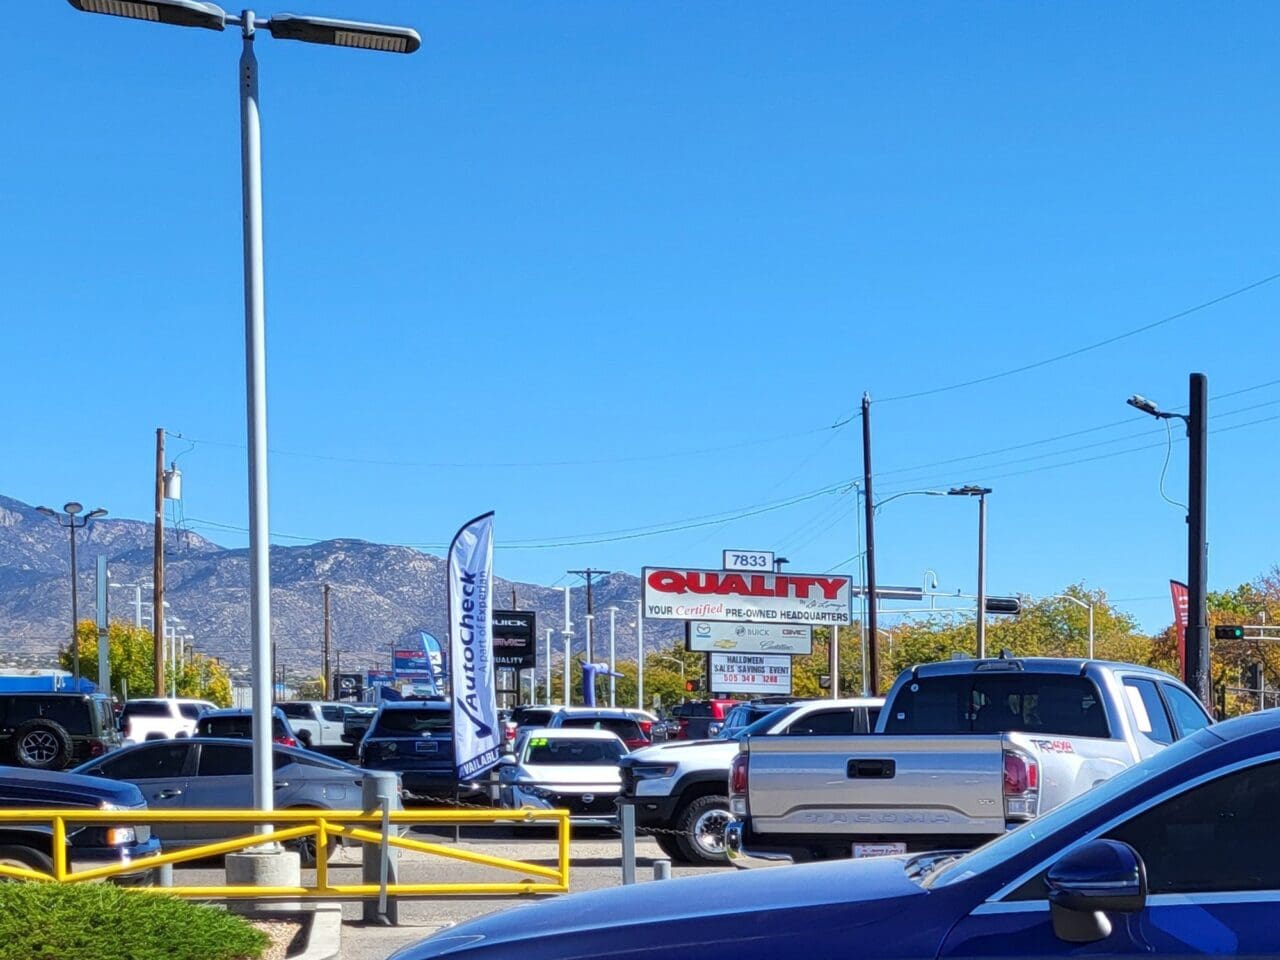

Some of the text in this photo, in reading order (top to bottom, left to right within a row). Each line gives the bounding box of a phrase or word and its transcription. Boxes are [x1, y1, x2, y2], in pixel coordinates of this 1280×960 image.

[732, 555, 766, 567] 7833
[648, 570, 848, 599] QUALITY
[649, 603, 848, 621] YOUR Certified PRE-OWNED HEADQUARTERS
[476, 570, 488, 673] A part of Experian
[459, 570, 478, 711] AutoCheck
[495, 656, 523, 664] UALITY
[727, 656, 764, 664] HALLOWEEN
[714, 663, 789, 674] SALES SAVINGS EVENT
[723, 673, 737, 681] 505
[805, 813, 950, 823] TACOMA
